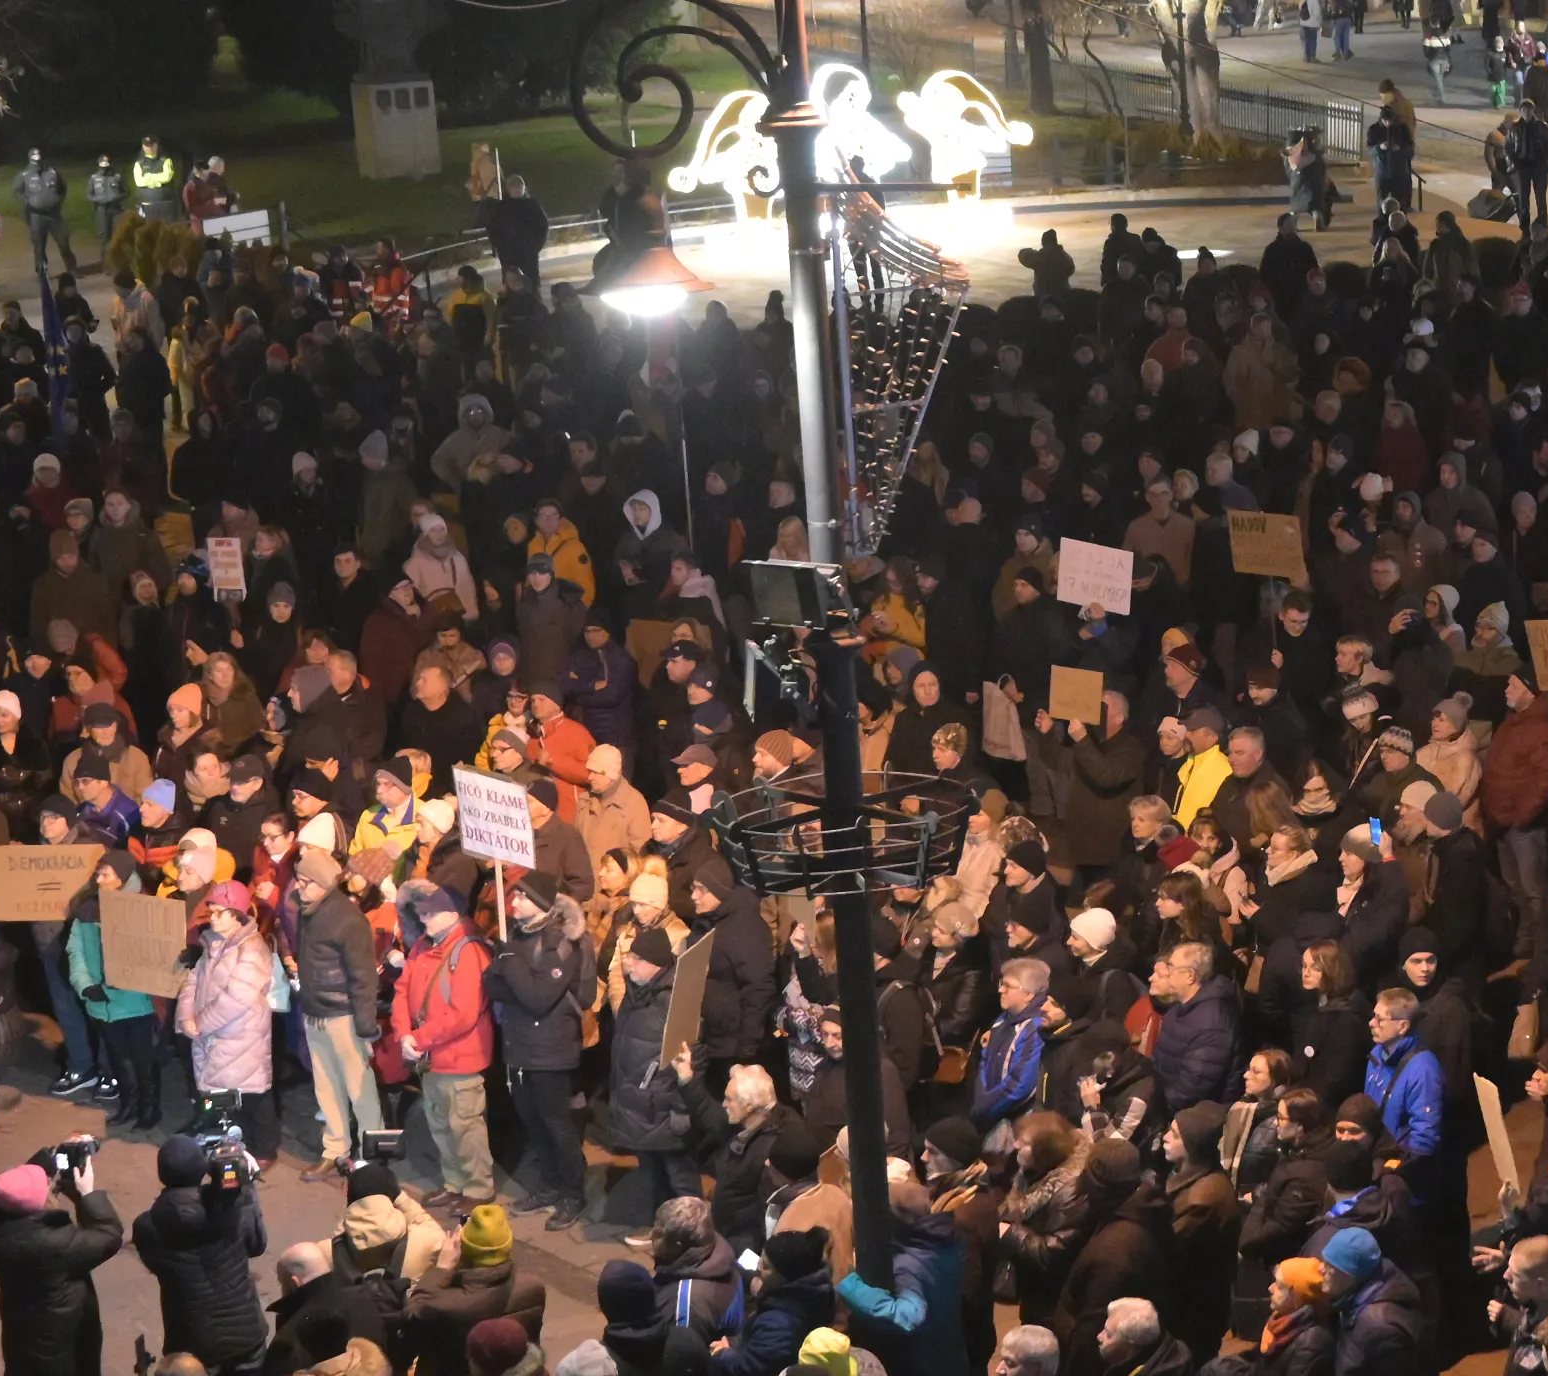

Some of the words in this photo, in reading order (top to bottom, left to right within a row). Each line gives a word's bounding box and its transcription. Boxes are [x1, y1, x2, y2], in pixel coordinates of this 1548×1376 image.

[486, 789, 526, 810] KLAME
[462, 804, 481, 819] AKO
[484, 810, 528, 831] ZBABELÝ
[464, 824, 532, 856] DIKTÁTOR
[8, 854, 86, 872] DEMOKRACIA
